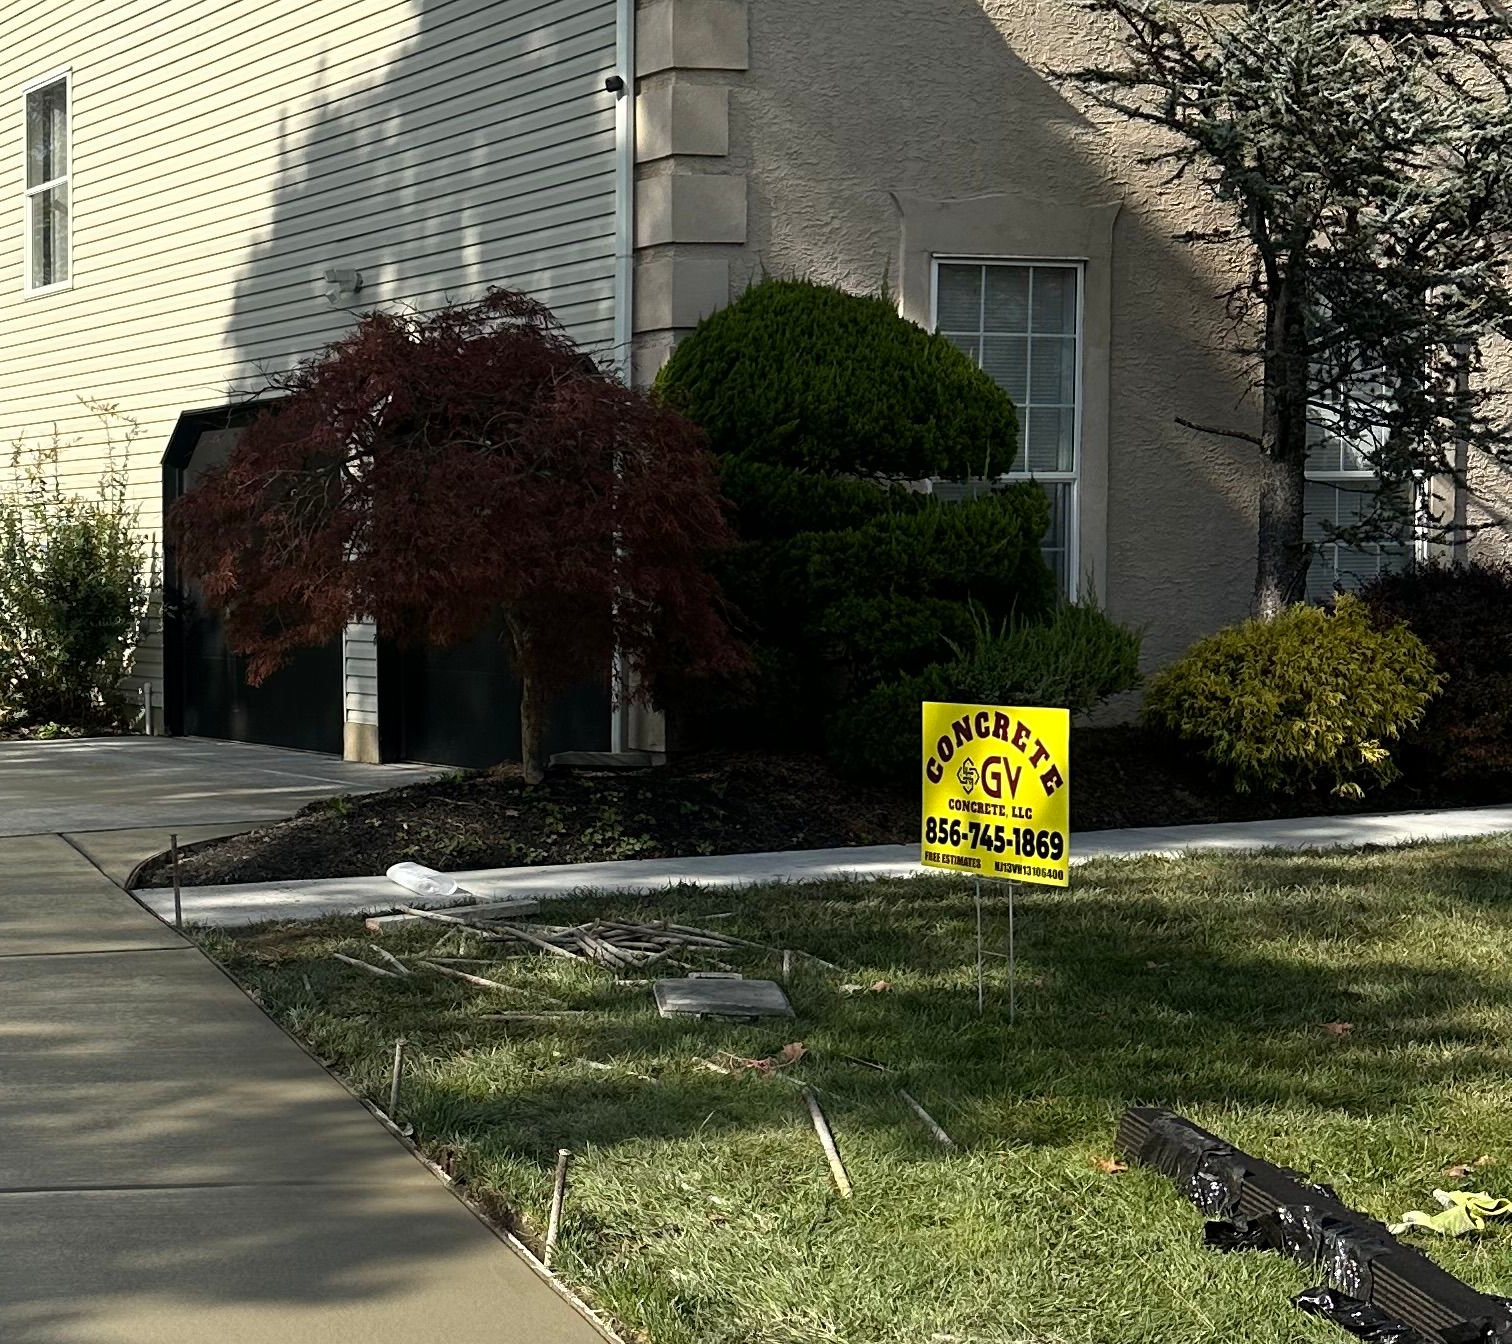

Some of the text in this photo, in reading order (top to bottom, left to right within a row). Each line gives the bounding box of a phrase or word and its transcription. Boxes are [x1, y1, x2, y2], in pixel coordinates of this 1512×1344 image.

[926, 710, 1064, 797] CONCRETE
[981, 755, 1023, 800] GV
[948, 798, 1032, 819] CONCRETE, LLC
[925, 817, 1063, 860] 856-745-1869
[925, 851, 981, 868] FREE ESTIMATES
